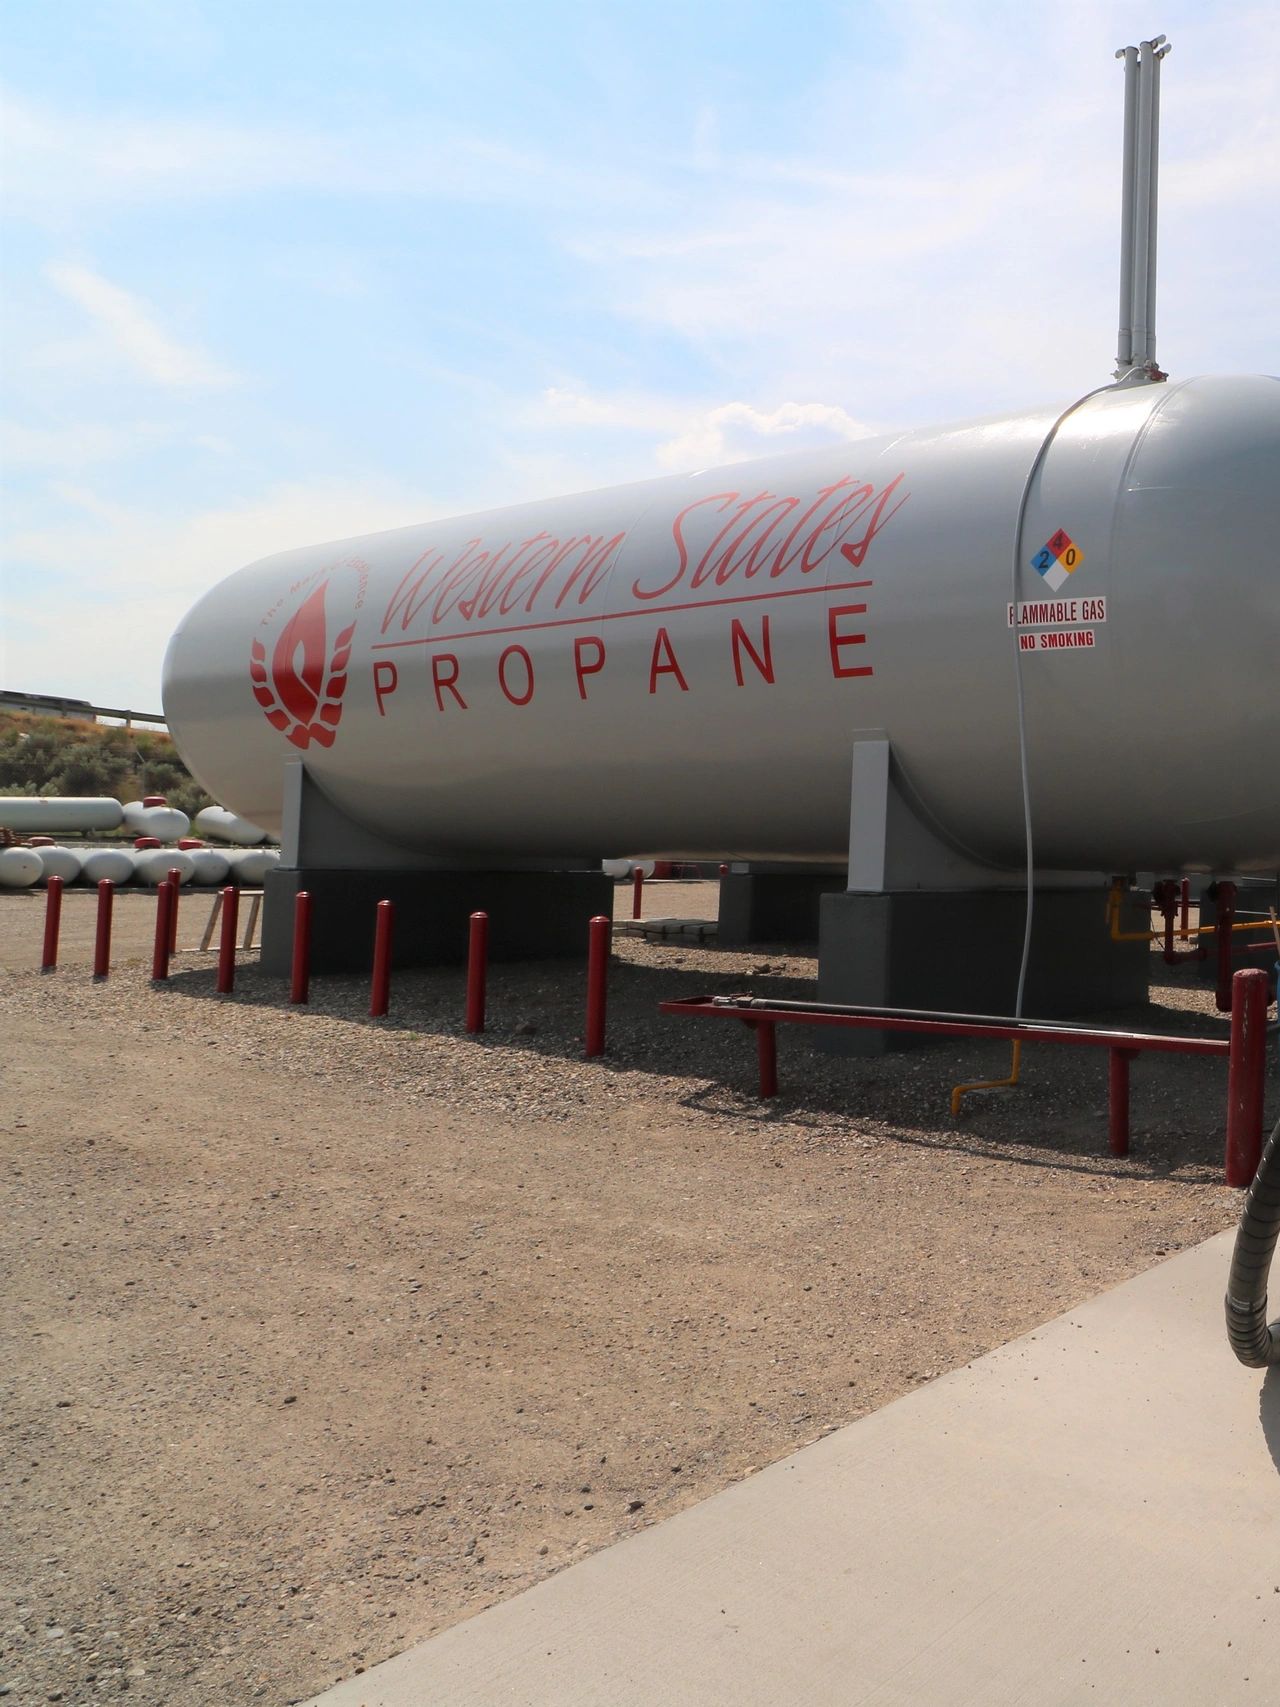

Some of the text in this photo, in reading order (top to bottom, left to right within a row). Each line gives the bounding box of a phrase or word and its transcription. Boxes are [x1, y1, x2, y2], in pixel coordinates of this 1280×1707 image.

[1053, 534, 1063, 548] 4
[380, 531, 626, 634] Western
[632, 472, 911, 600] States
[1039, 551, 1050, 568] 2
[1066, 548, 1076, 565] 0
[1082, 599, 1105, 621] GAS
[1020, 631, 1094, 650] NO SMOKING
[373, 603, 874, 717] PROPANE
